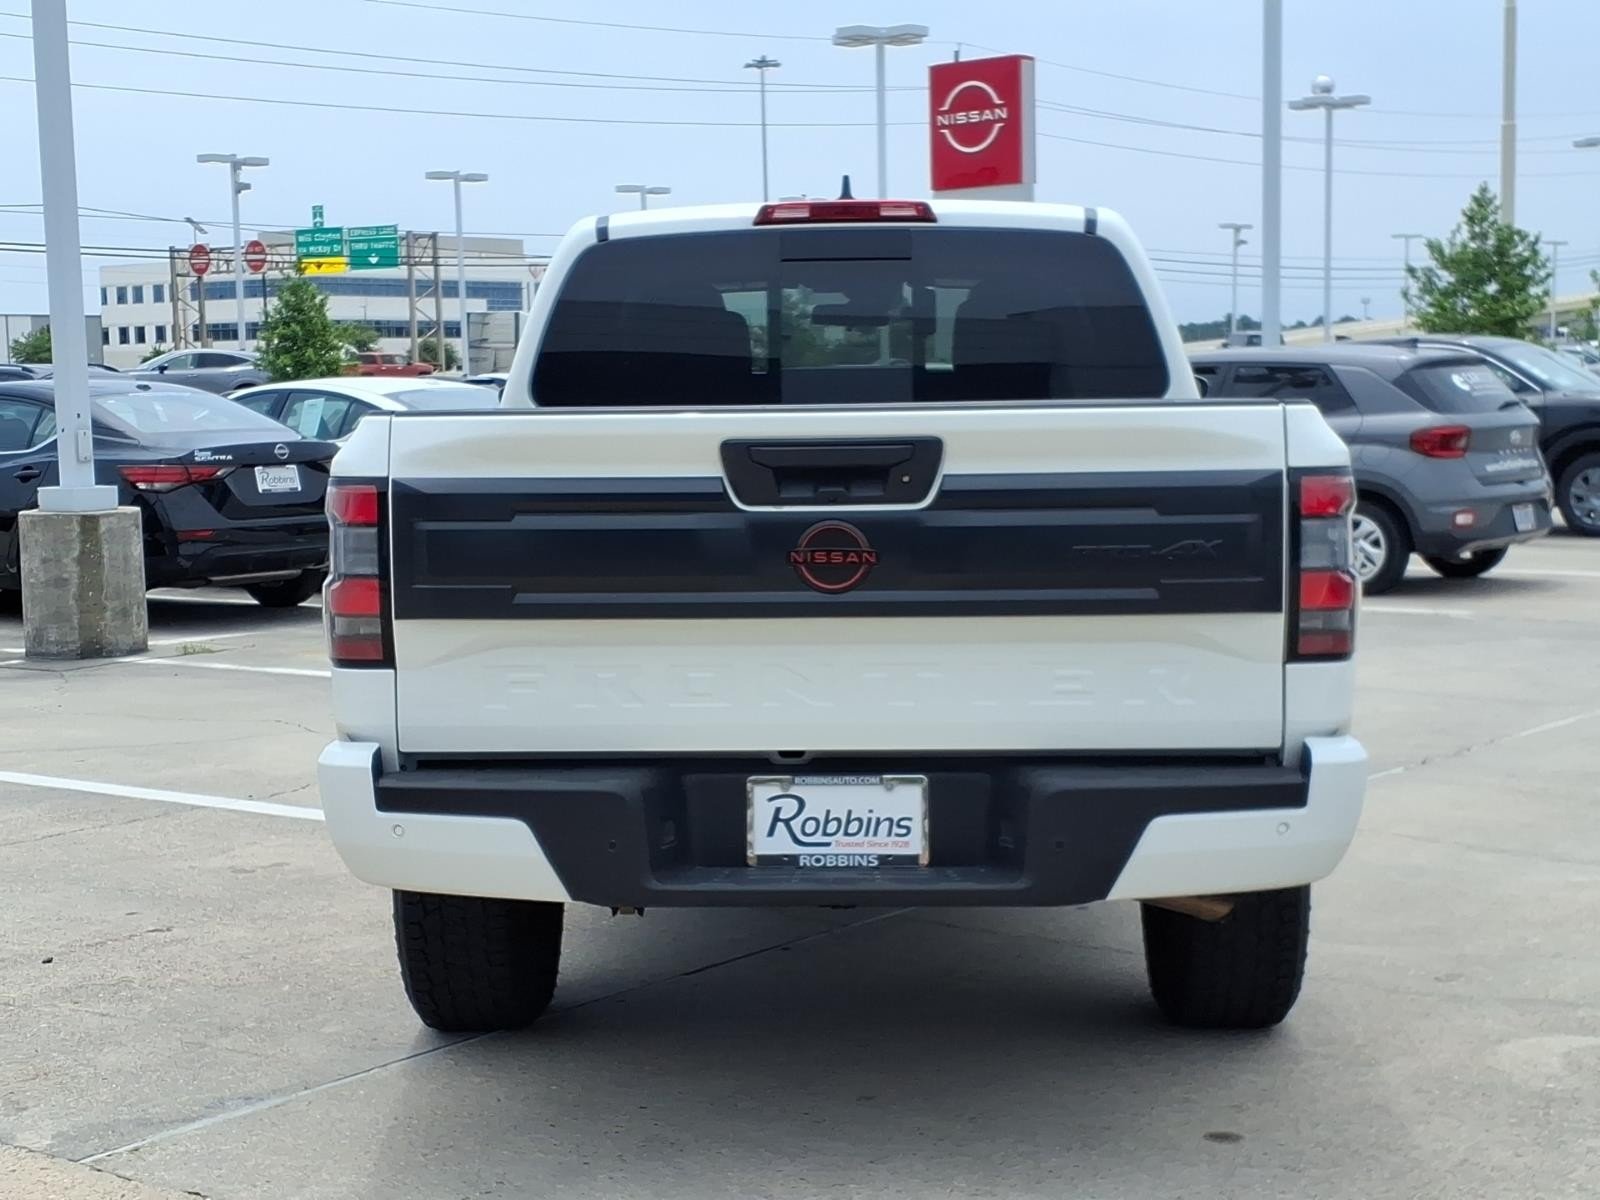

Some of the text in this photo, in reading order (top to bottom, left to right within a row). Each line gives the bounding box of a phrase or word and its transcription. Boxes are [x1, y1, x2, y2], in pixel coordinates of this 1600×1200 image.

[936, 107, 1008, 126] NISSAN
[790, 551, 877, 563] NISSAN
[795, 776, 880, 785] ROBBINSAUTO.COM
[766, 793, 913, 848] Robbins
[834, 840, 864, 849] Trusted
[866, 840, 888, 849] Since
[799, 854, 879, 867] ROBBINS
